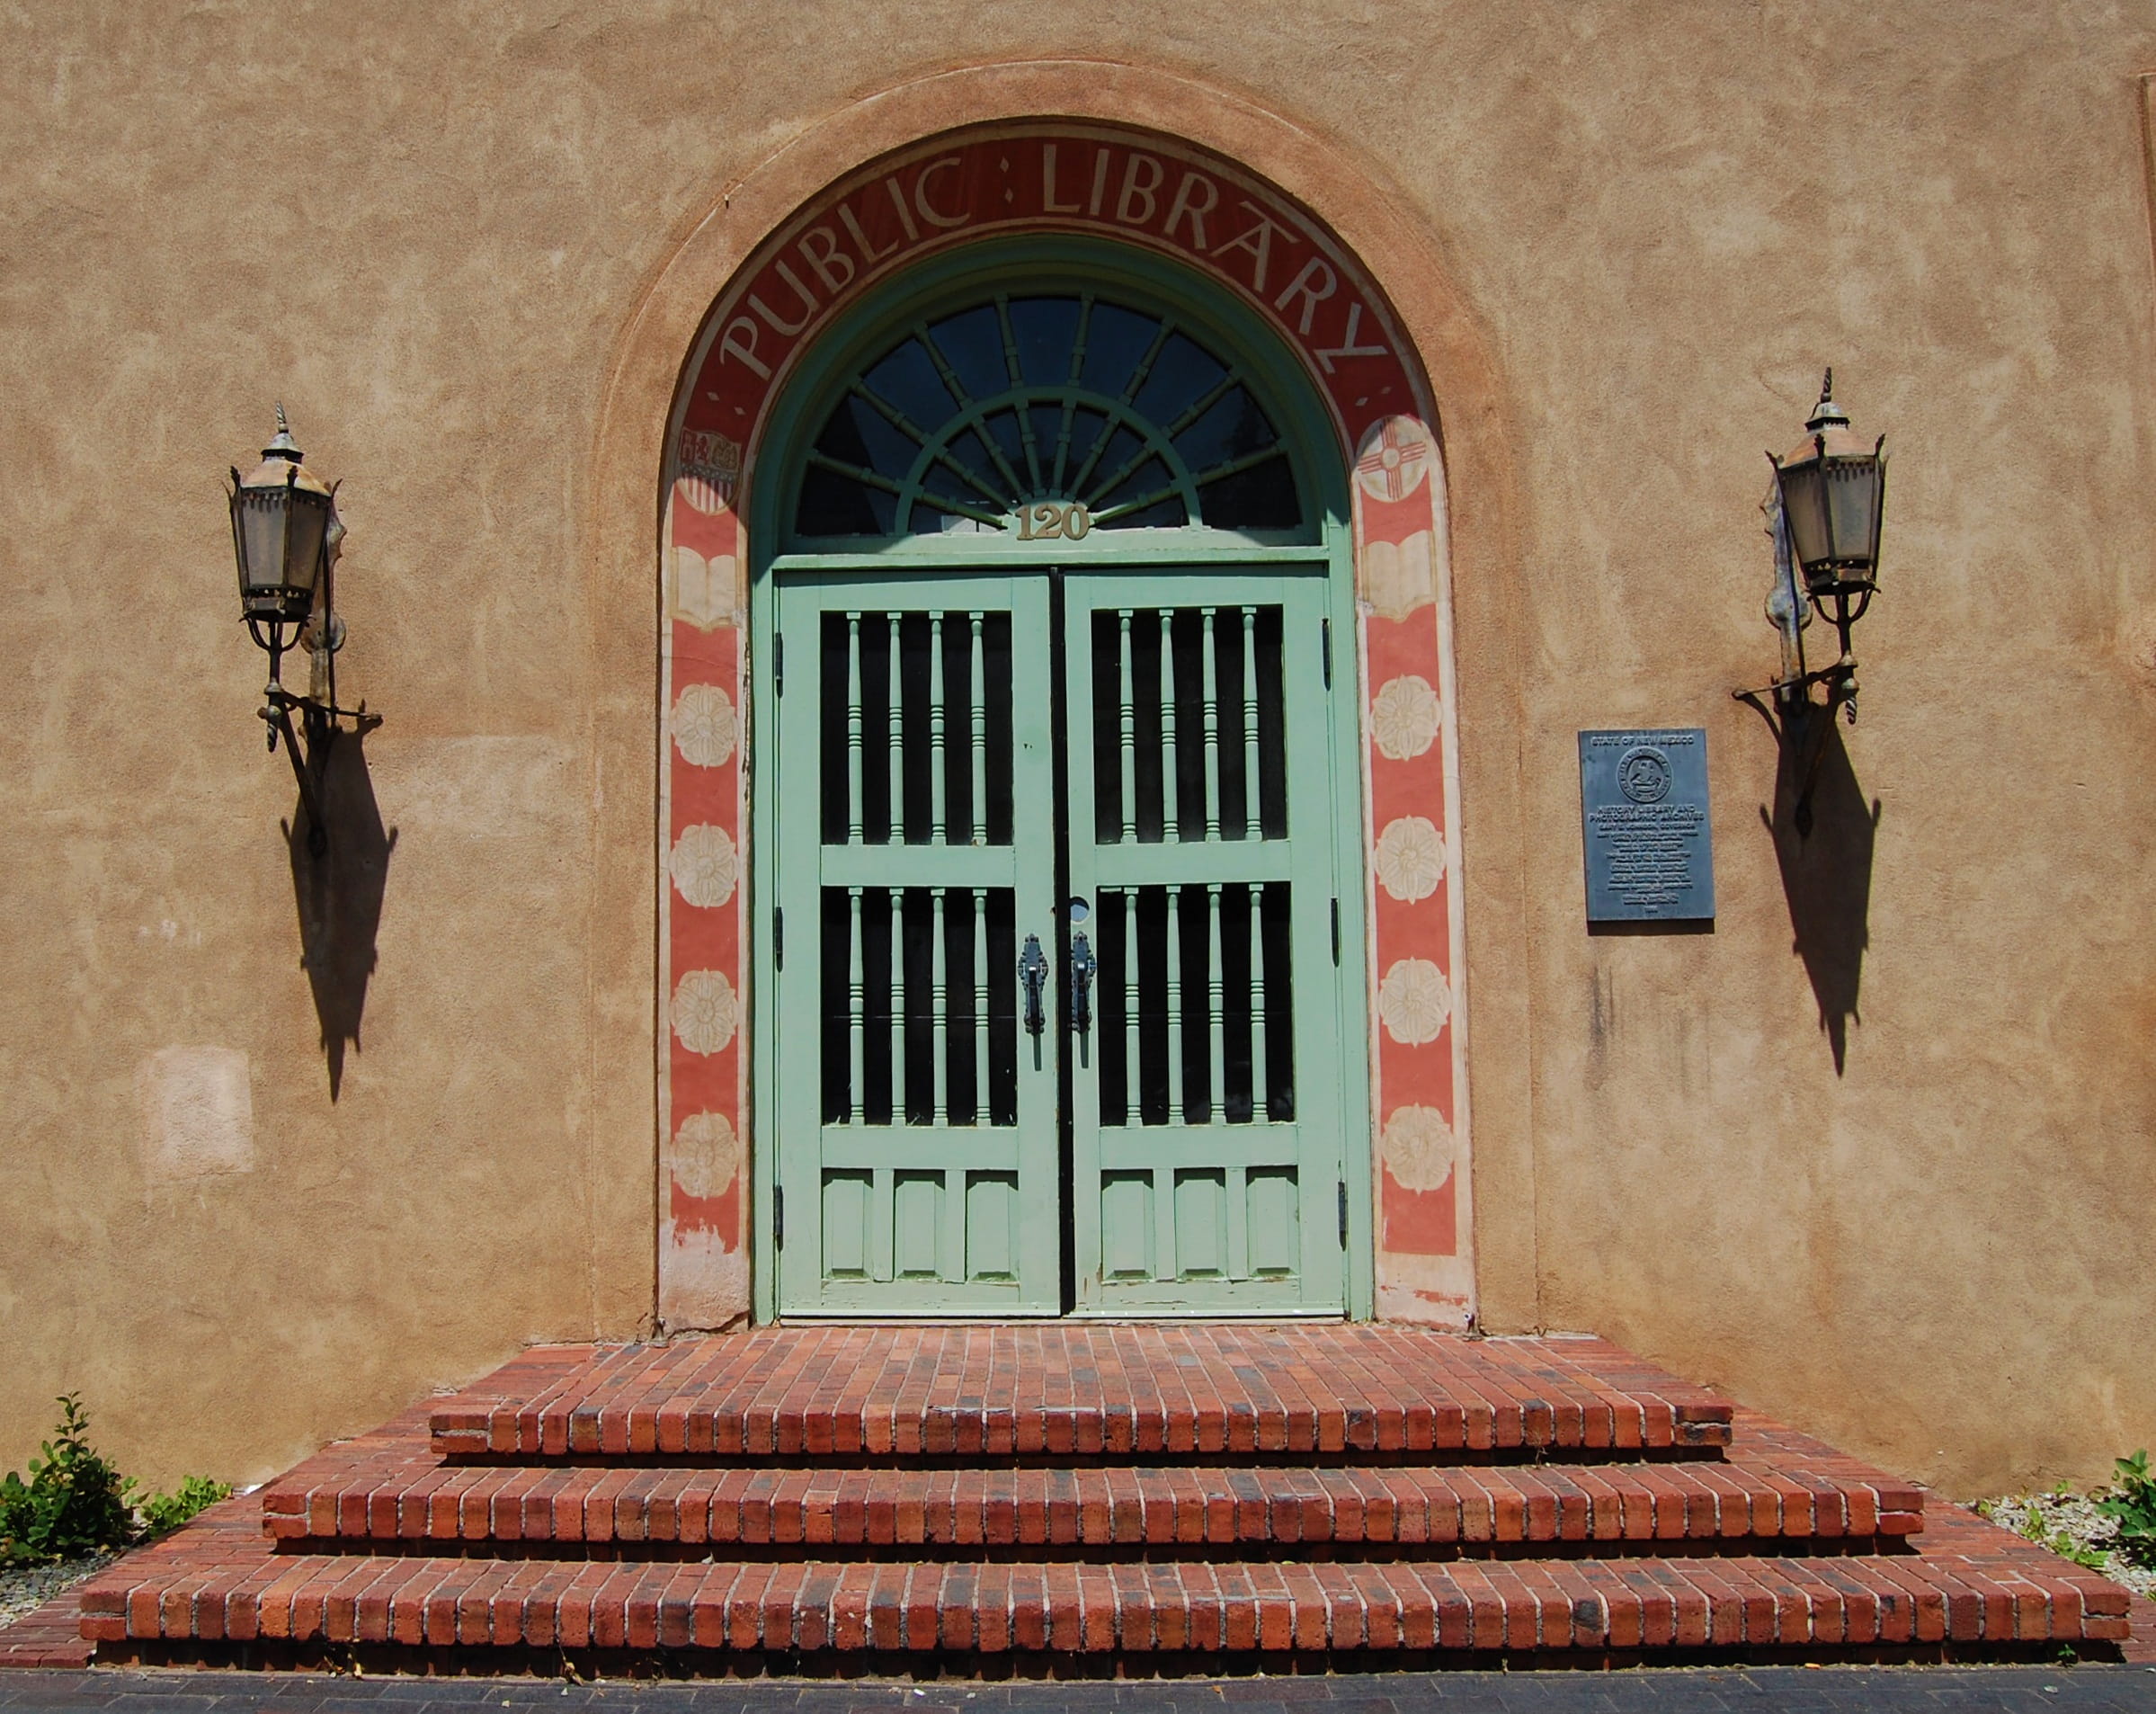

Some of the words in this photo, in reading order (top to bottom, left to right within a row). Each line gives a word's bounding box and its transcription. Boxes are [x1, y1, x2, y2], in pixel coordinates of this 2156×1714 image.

[718, 156, 971, 382] PUBLIC
[1042, 143, 1389, 375] LIBRARY
[1014, 503, 1090, 541] 120
[1590, 736, 1619, 746] STATE
[1621, 736, 1635, 746] OF
[1636, 735, 1657, 745] NEW
[1659, 734, 1695, 745] MEXICO
[1677, 804, 1696, 813] AND
